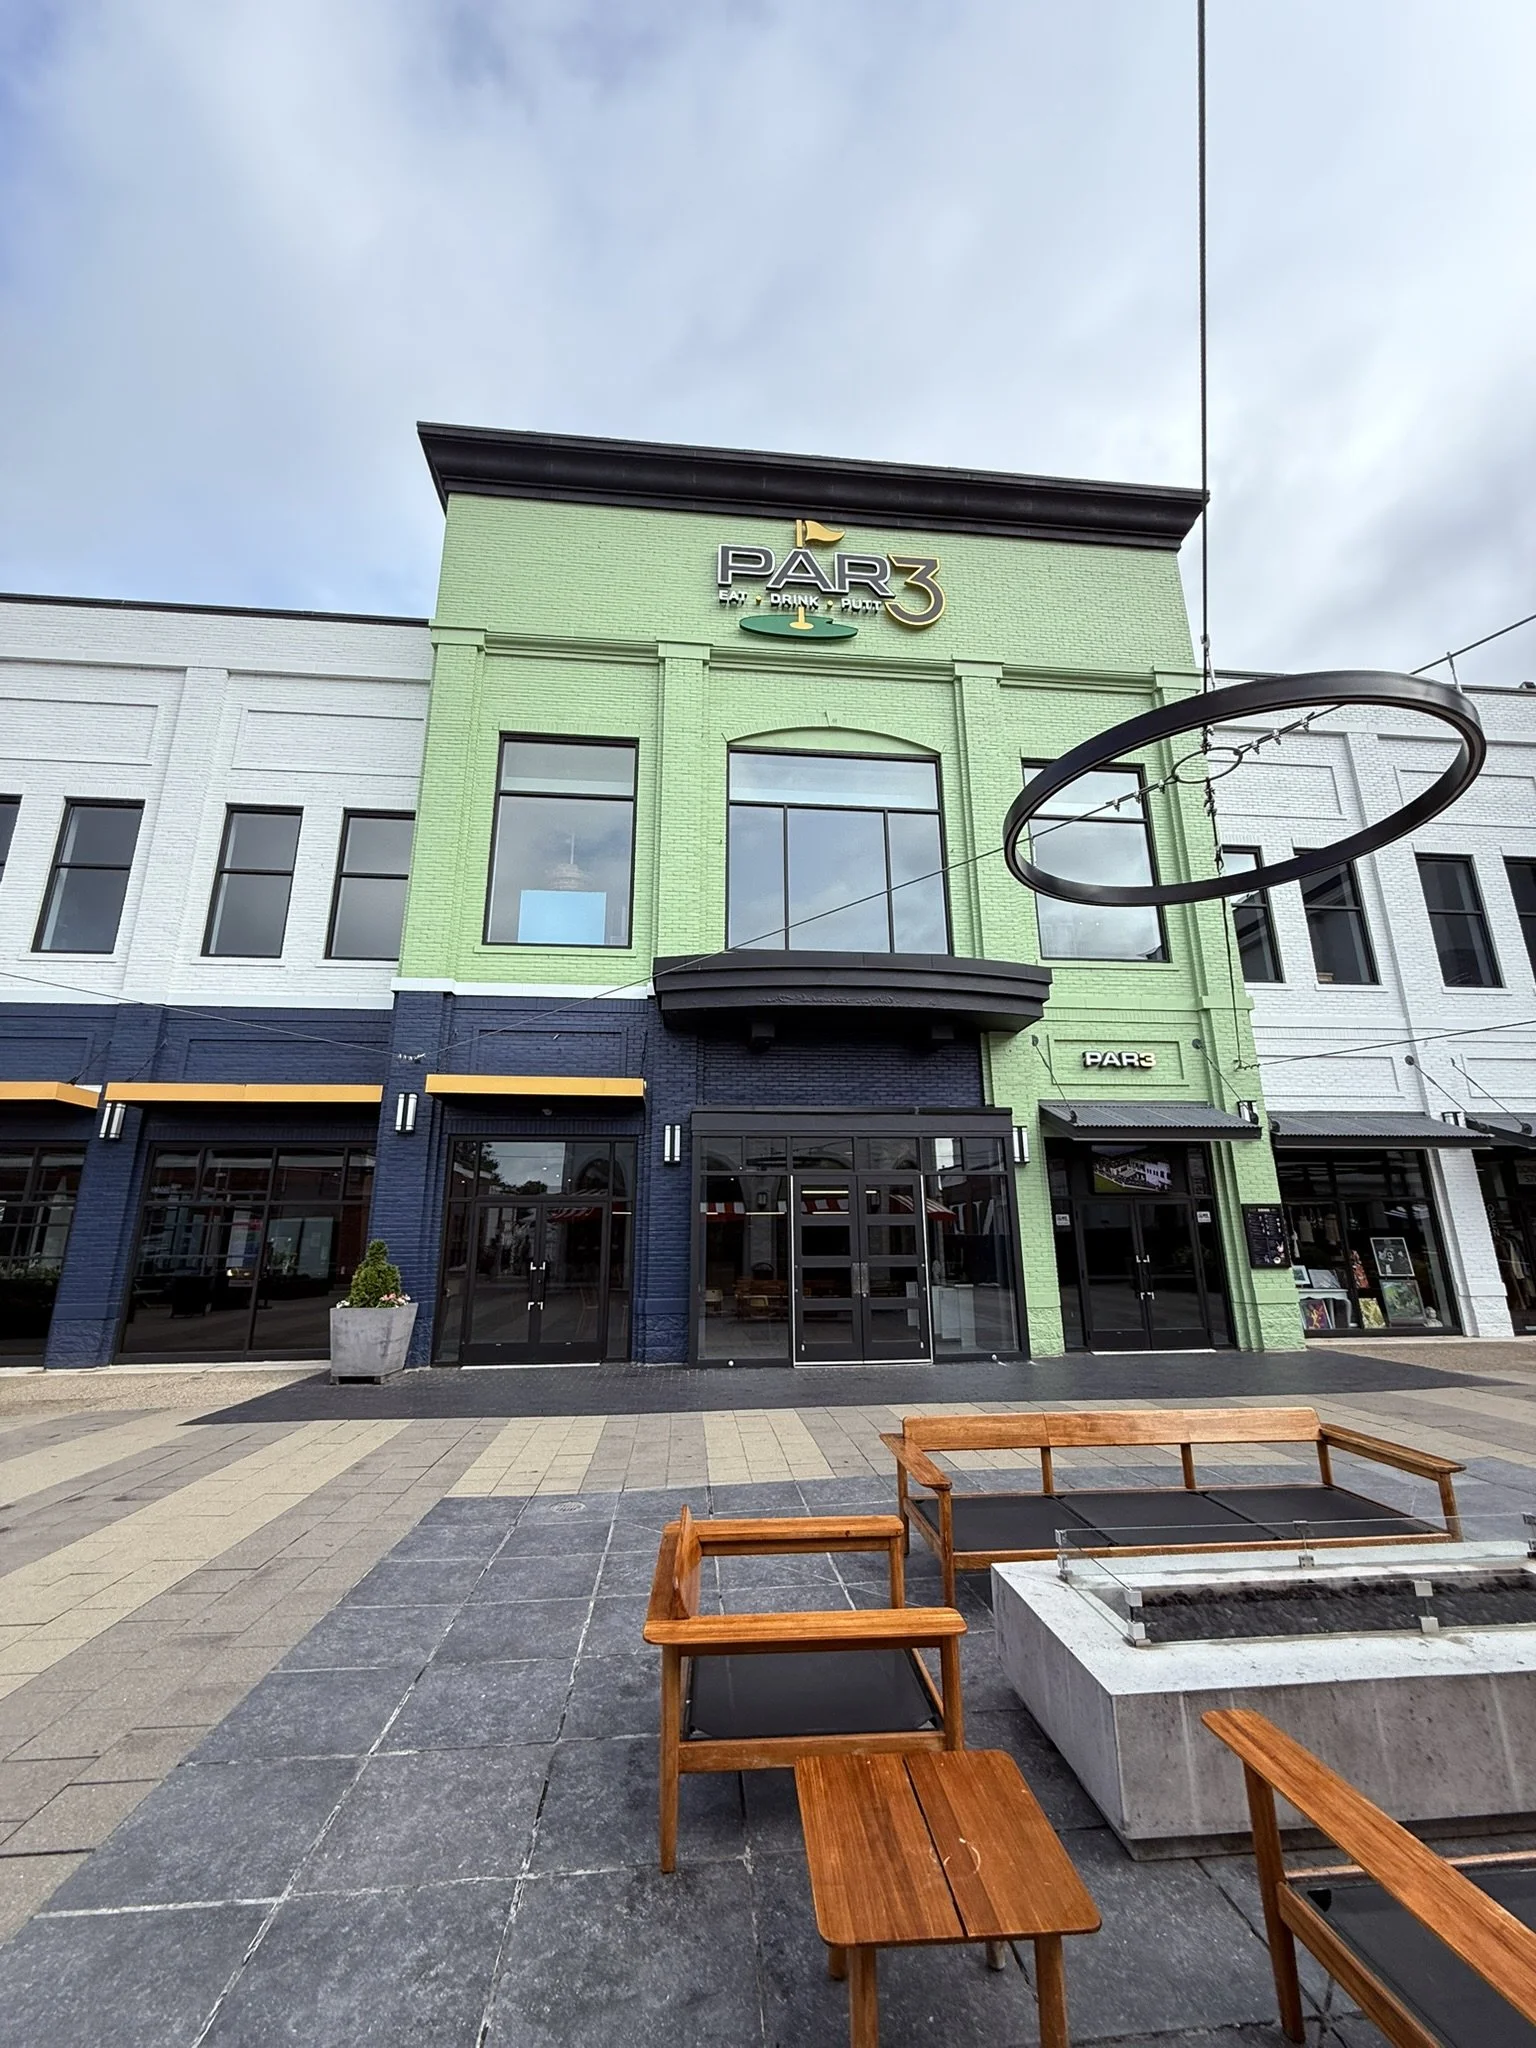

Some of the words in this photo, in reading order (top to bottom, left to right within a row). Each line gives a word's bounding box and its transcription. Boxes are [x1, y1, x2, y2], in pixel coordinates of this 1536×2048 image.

[718, 589, 748, 604] EAT
[770, 593, 820, 608] DRINK
[841, 598, 882, 612] PUTT
[1083, 1051, 1157, 1069] PAR3
